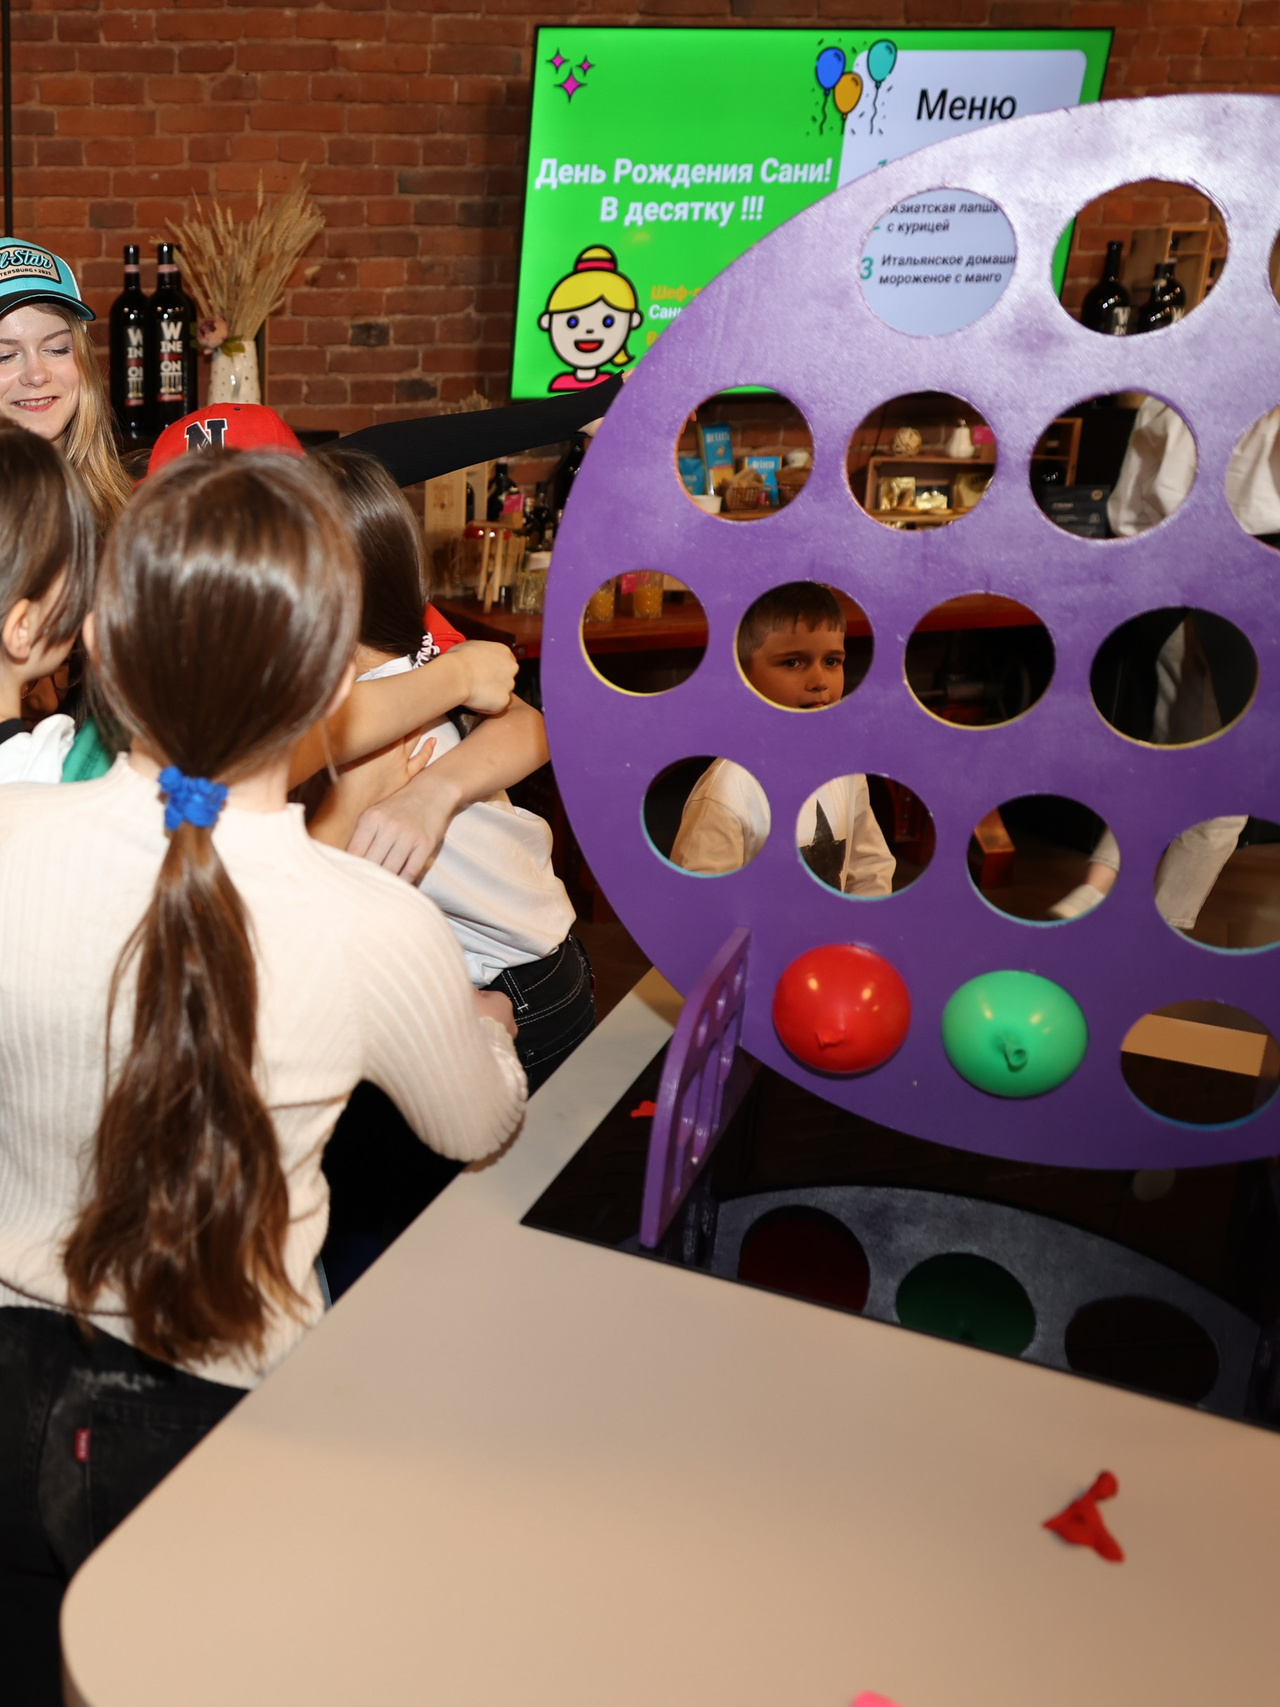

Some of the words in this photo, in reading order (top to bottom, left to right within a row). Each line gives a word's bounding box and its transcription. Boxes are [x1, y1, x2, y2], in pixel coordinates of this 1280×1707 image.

[916, 88, 1018, 120] Меню
[534, 157, 607, 190] День
[613, 157, 754, 188] Рождения
[760, 156, 833, 184] Сани!
[600, 196, 619, 222] В
[623, 200, 735, 228] десятку
[890, 202, 956, 214] Азиатская
[959, 203, 999, 214] лапша
[897, 219, 950, 235] курицей
[860, 256, 874, 280] 3
[881, 254, 964, 267] Итальянское
[879, 274, 952, 286] мороженое
[965, 273, 1002, 284] манго
[160, 340, 183, 353] INE
[160, 360, 182, 372] ON
[184, 418, 228, 452] N
